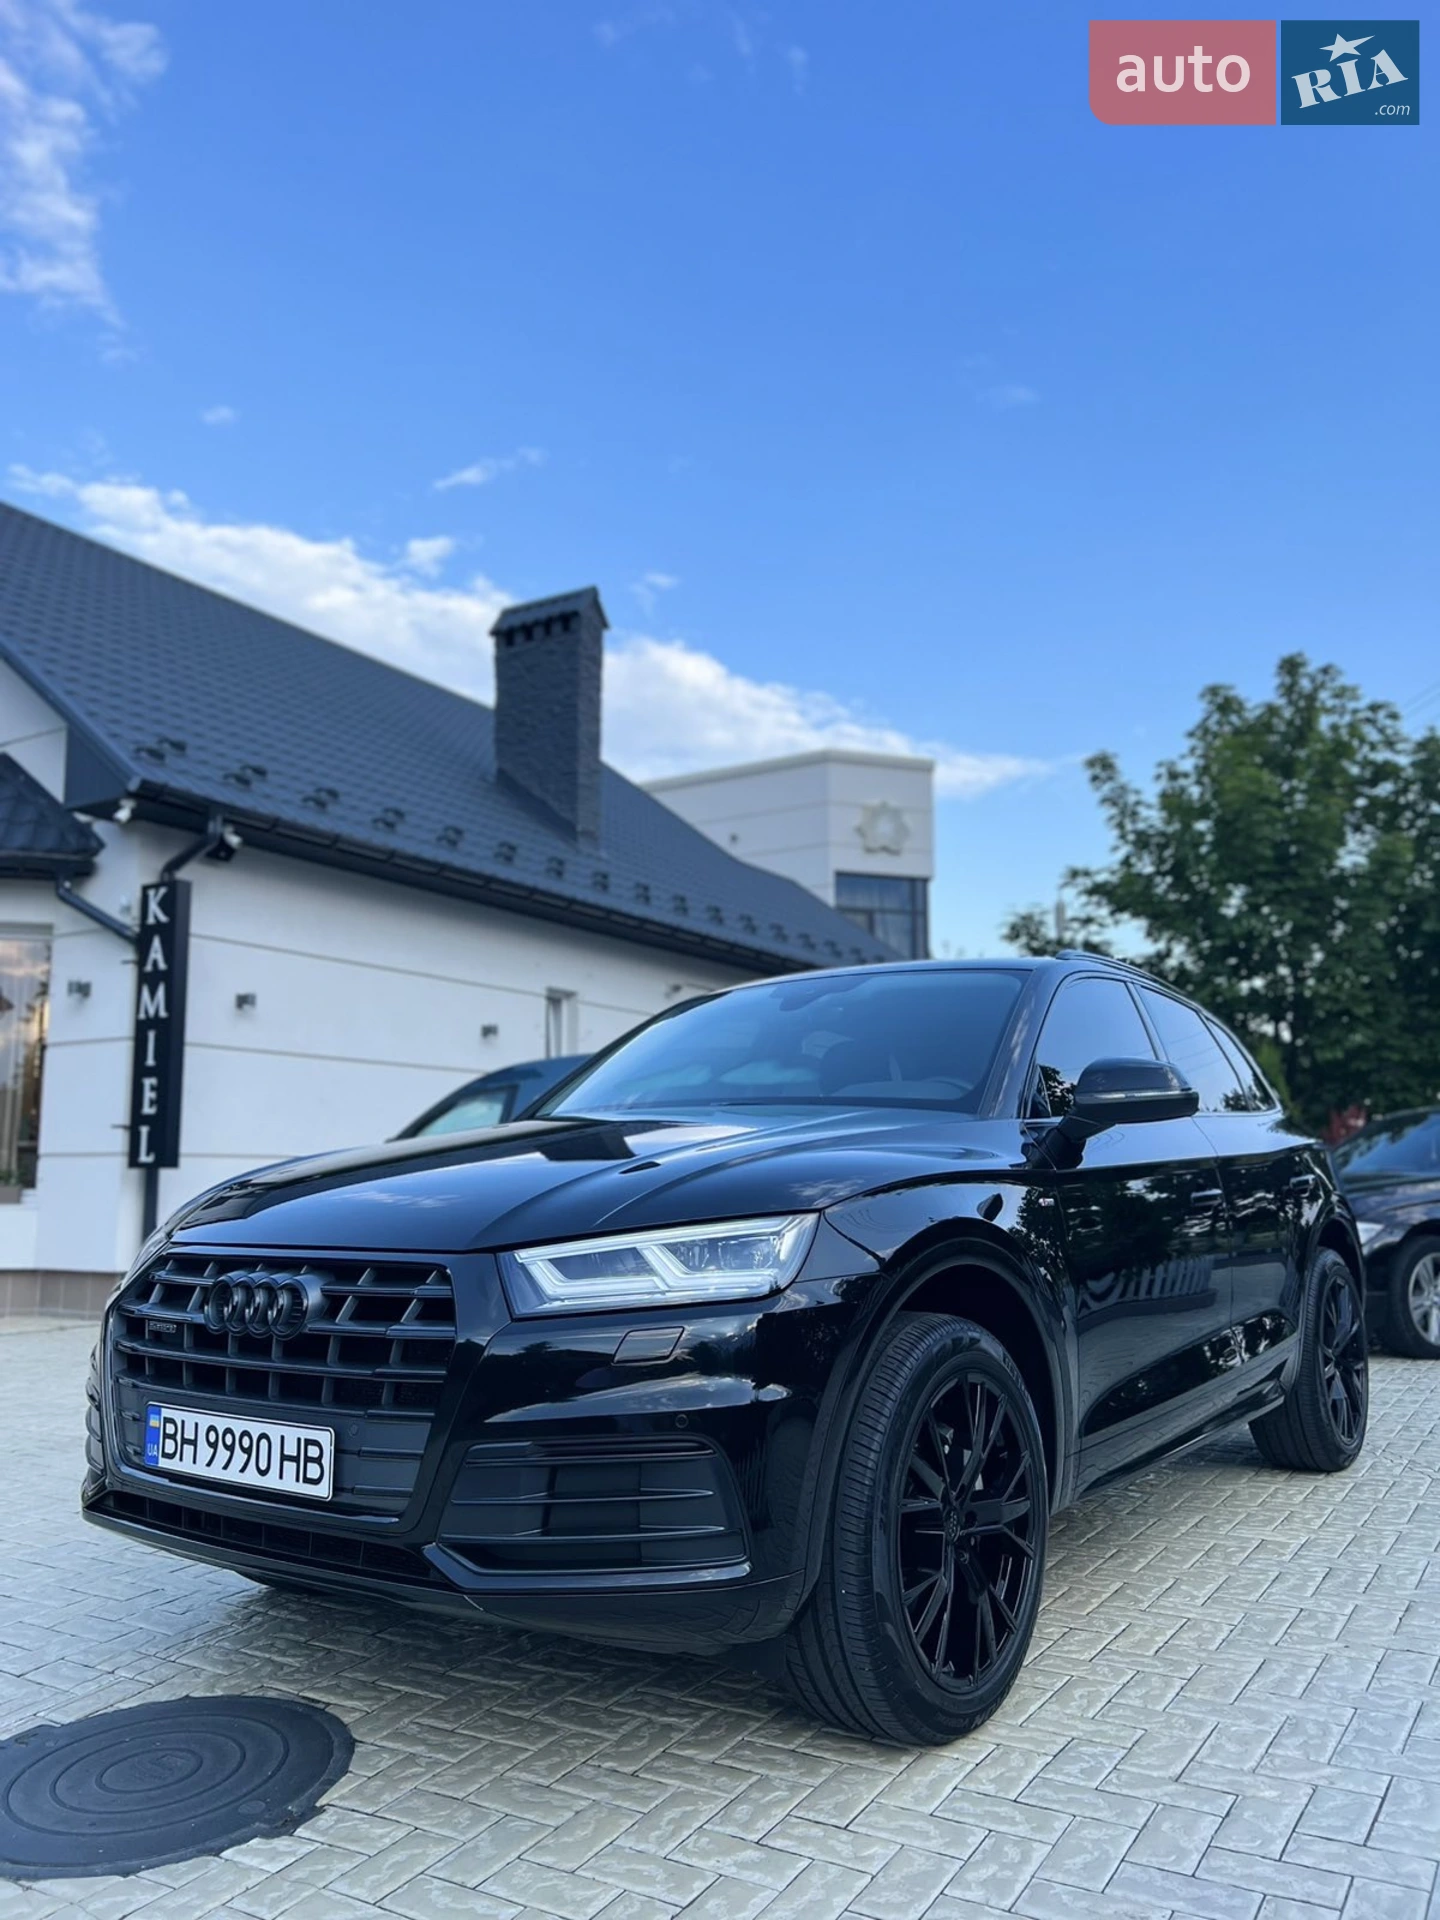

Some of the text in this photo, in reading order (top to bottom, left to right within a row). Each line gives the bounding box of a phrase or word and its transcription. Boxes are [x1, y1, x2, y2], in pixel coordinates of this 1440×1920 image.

[138, 887, 169, 1163] KAMIEL
[147, 1443, 158, 1457] UA
[161, 1416, 324, 1485] BH 9990 HB
